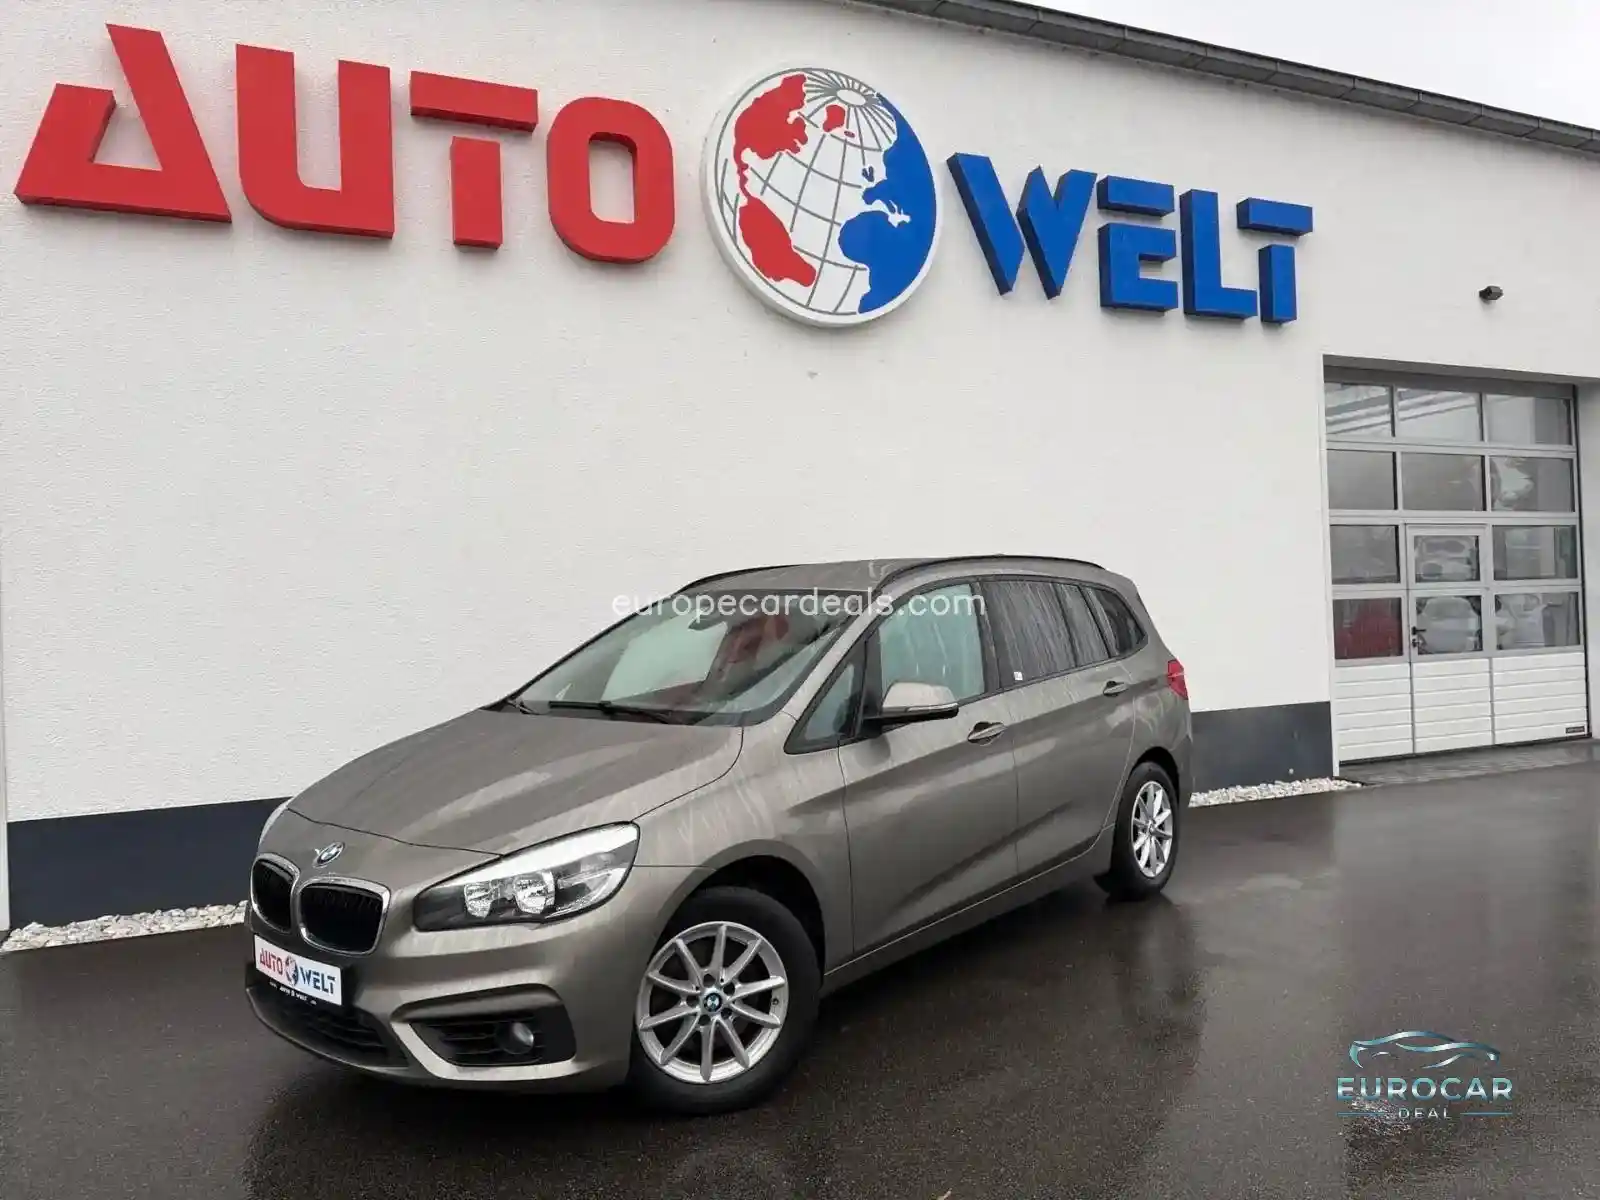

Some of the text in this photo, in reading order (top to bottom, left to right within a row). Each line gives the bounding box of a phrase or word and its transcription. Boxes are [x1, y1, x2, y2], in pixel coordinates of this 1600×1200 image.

[14, 23, 1313, 325] AUTO WELT
[259, 947, 284, 976] AUTO
[299, 966, 336, 995] WELT
